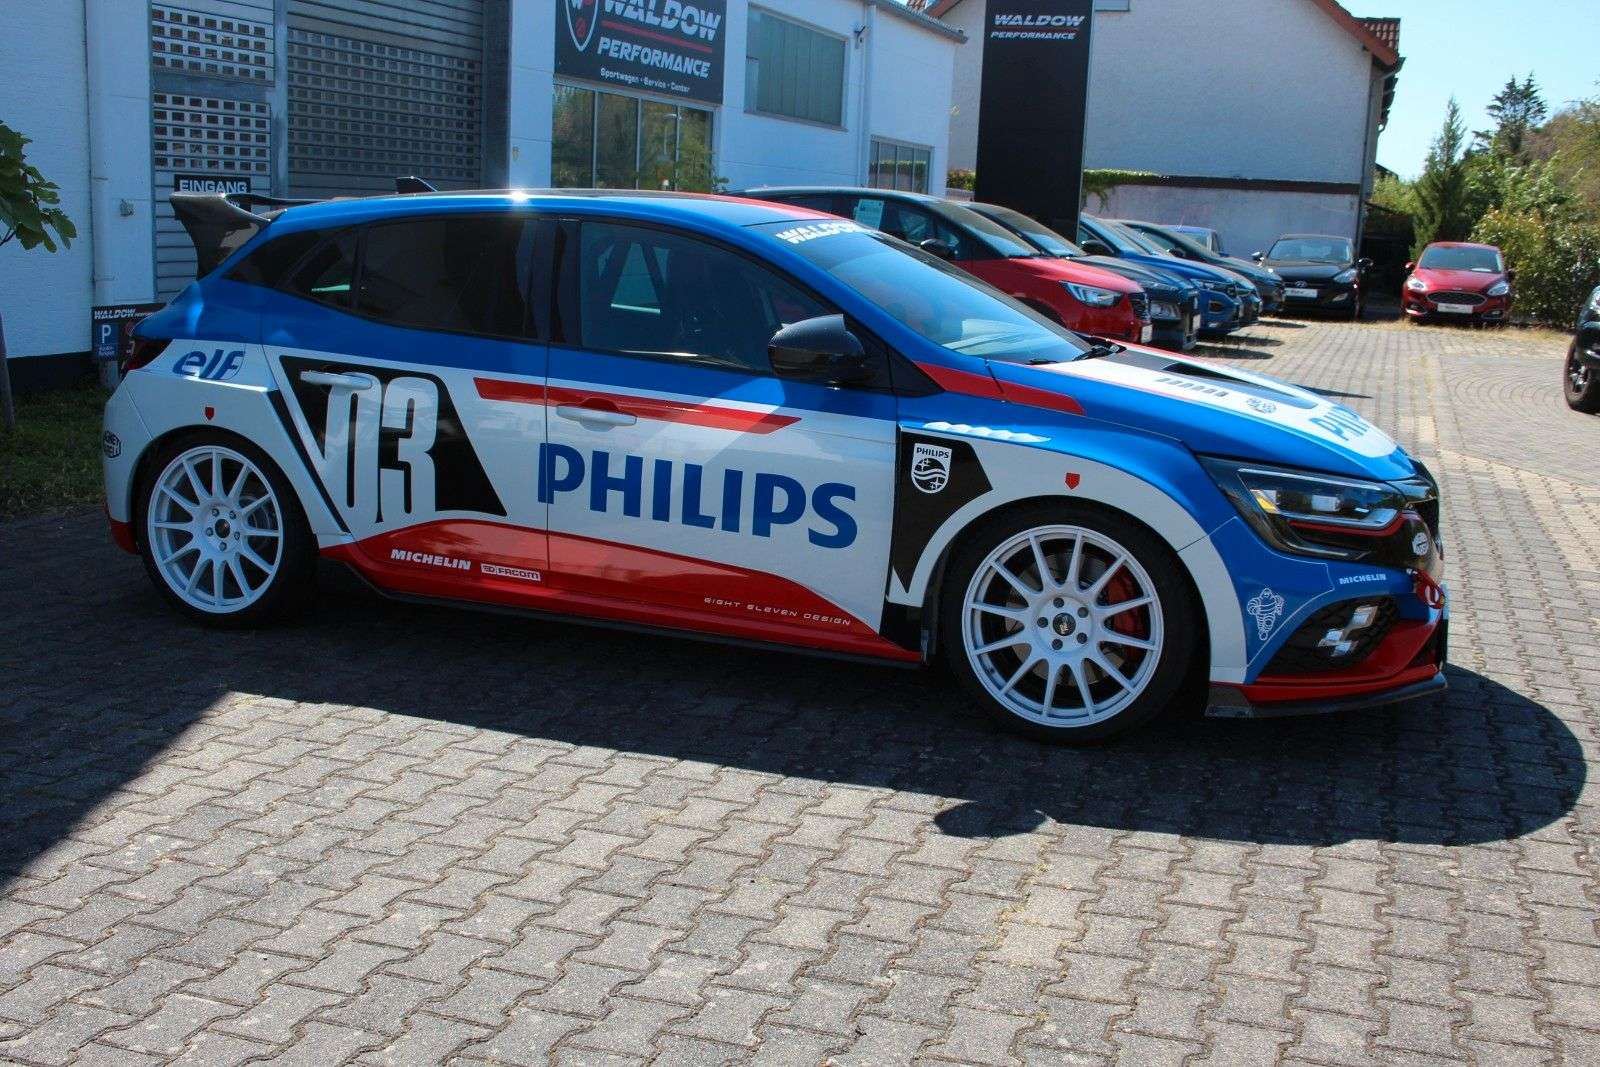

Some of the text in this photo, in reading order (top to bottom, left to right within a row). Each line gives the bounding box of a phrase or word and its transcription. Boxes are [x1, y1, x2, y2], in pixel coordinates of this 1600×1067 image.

[993, 14, 1085, 27] WALDOW
[990, 31, 1076, 40] PERFORMANCE
[597, 36, 711, 79] PERFORMANCE
[179, 179, 248, 194] EINGANG
[102, 324, 112, 344] P
[172, 349, 245, 380] elf
[916, 446, 950, 459] PHILIPS
[537, 442, 858, 549] PHILIPS
[390, 549, 472, 571] MICHELIN
[1339, 573, 1387, 585] MICHELIN
